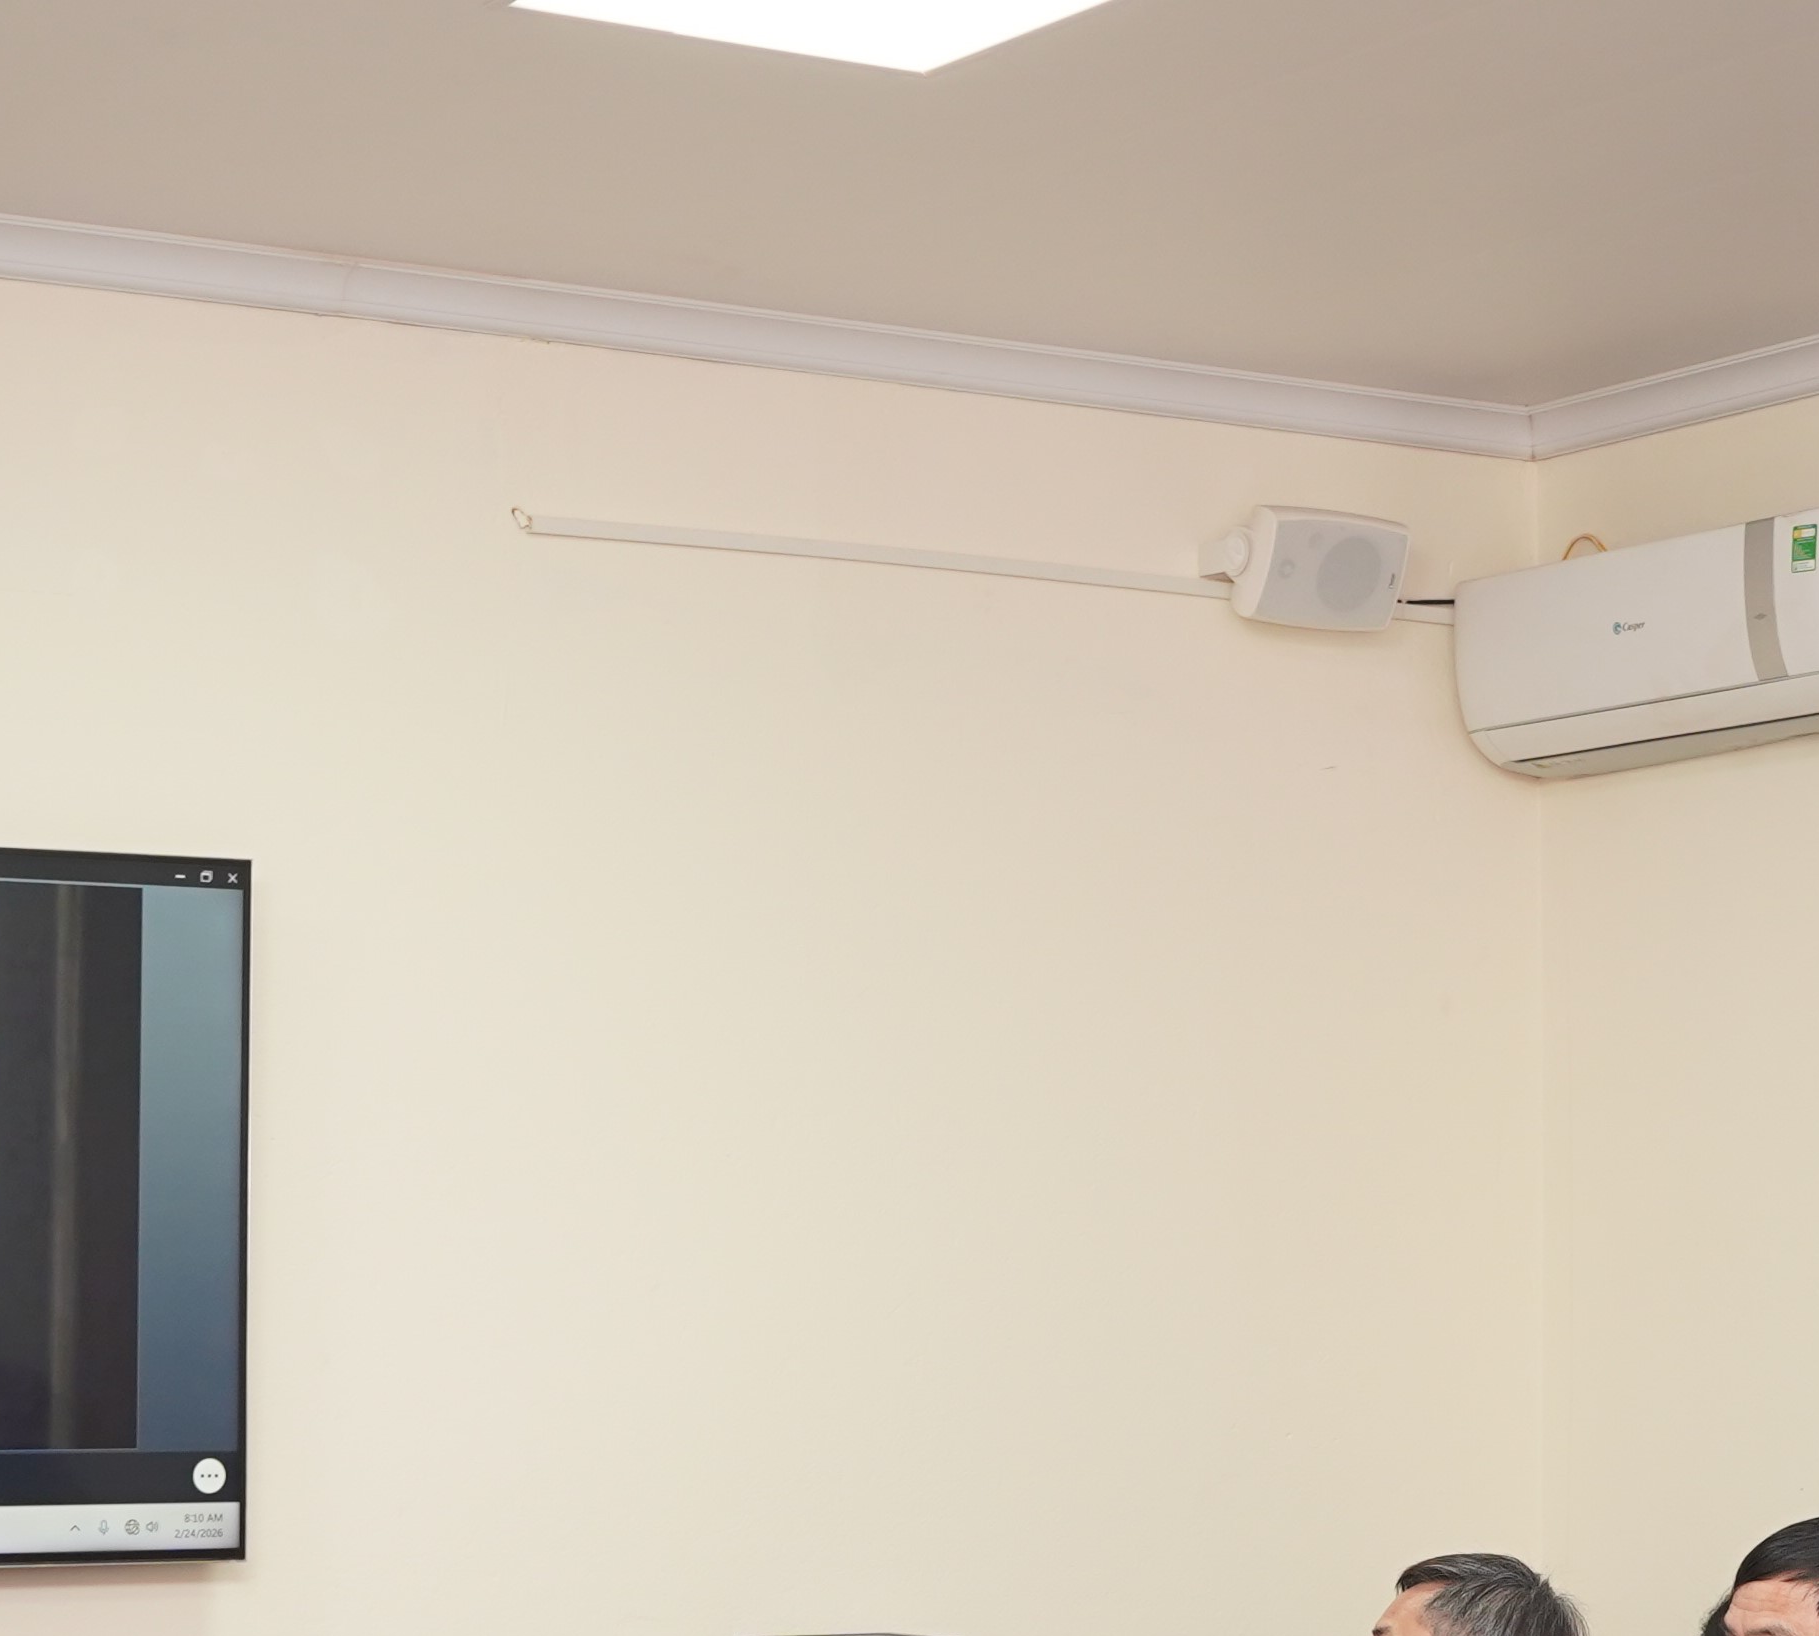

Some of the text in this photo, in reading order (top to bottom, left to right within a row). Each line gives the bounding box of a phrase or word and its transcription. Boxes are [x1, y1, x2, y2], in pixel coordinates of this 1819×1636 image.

[183, 1512, 224, 1523] 8:10 AM
[174, 1528, 224, 1539] 2/24/2026
